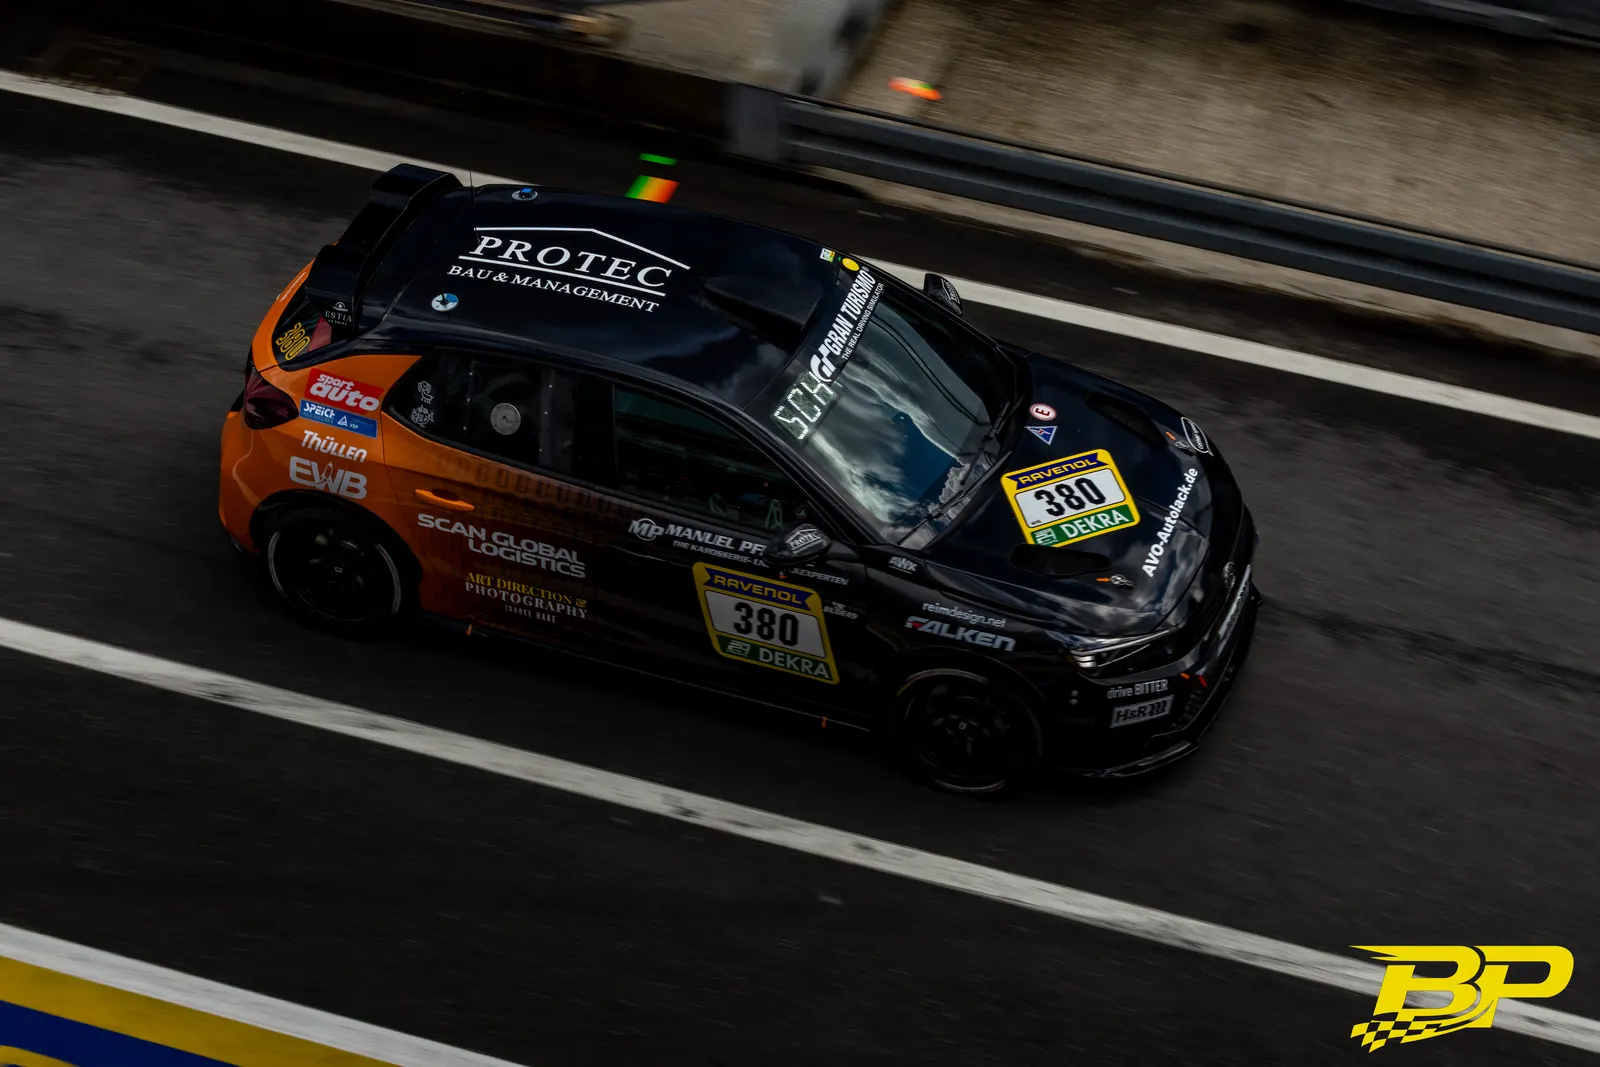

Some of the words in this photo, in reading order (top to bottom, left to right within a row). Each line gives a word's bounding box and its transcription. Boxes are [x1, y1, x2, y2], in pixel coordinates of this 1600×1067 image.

[469, 235, 672, 288] PROTEC
[325, 310, 352, 322] ESTIA
[825, 314, 854, 356] GRAN
[840, 269, 876, 321] TURISMO
[841, 346, 853, 360] THE
[848, 332, 860, 348] REAL
[856, 309, 872, 332] DRIVING
[867, 282, 885, 310] SIMULATOR
[275, 321, 311, 361] 380
[309, 382, 380, 411] auto
[317, 373, 355, 391] sport
[289, 455, 367, 499] EWB
[1017, 457, 1098, 486] RAVENOL
[1034, 477, 1106, 516] 380
[417, 513, 487, 541] SCAN
[491, 531, 586, 565] GLOBAL
[628, 519, 665, 539] MP
[665, 523, 735, 550] MANUEL
[1062, 508, 1130, 539] DEKRA
[1141, 467, 1199, 578] AVO-Autolack.de
[468, 538, 586, 579] LOGISTICS
[672, 540, 690, 550] DIE
[465, 581, 587, 620] PHOTOGRAPHY
[466, 572, 494, 586] ART
[496, 578, 572, 604] DIRECTION
[713, 574, 803, 605] RAVENOL
[733, 601, 799, 646] 380
[921, 602, 1007, 628] reimdesign.net
[904, 615, 1017, 652] FALKEN
[759, 647, 832, 680] DEKRA
[1134, 679, 1169, 695] BITTER
